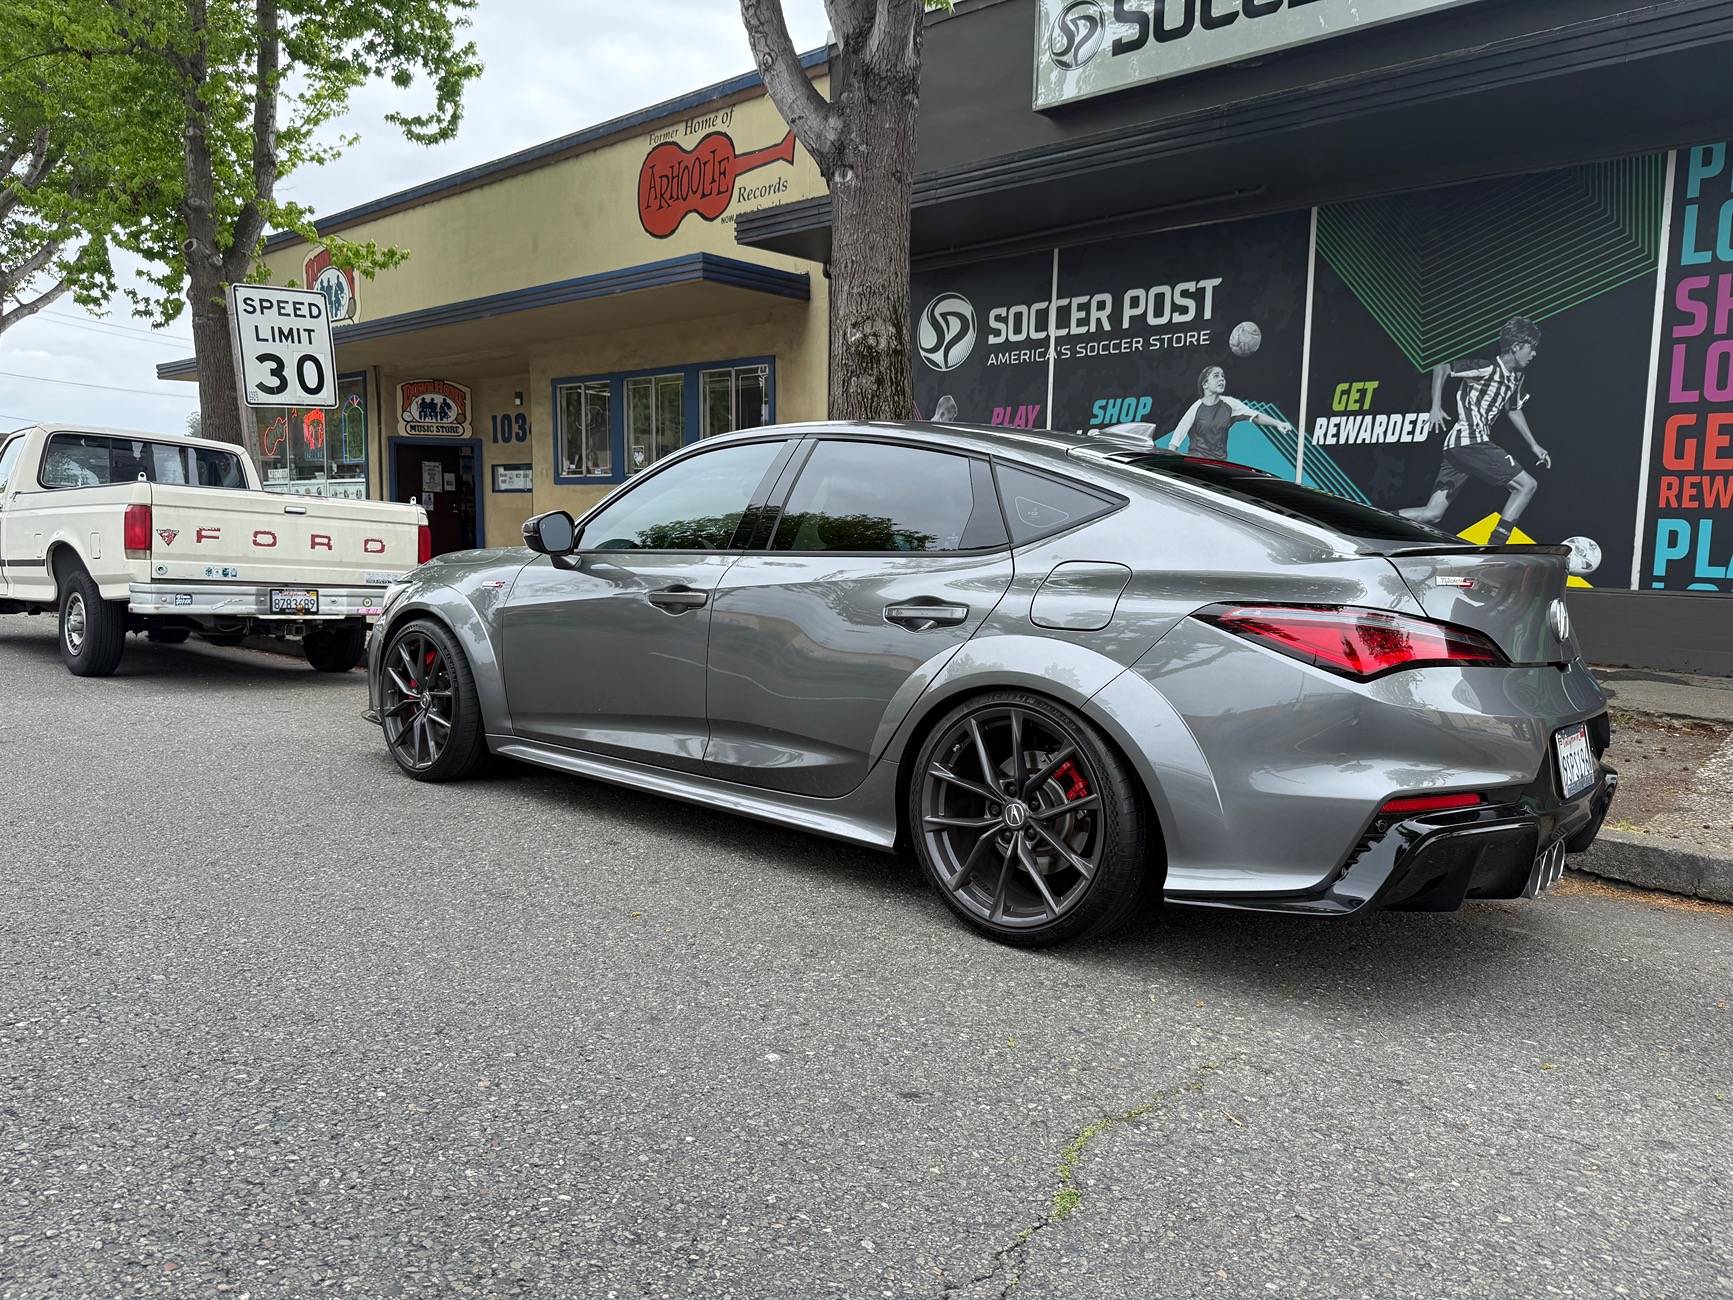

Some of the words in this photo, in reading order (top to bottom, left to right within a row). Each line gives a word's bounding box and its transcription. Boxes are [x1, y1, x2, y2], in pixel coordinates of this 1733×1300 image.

[648, 129, 680, 145] Former
[683, 116, 718, 136] Home
[721, 104, 736, 128] of
[644, 149, 730, 211] ARHOOLIE
[1687, 142, 1733, 199] P
[737, 176, 788, 203] Records
[243, 297, 322, 319] SPEED
[988, 293, 1112, 345] SOCCER
[1122, 277, 1223, 329] POST
[254, 325, 316, 345] LIMIT
[987, 346, 1072, 367] AMERICA'S
[1076, 337, 1143, 358] SOCCER
[1149, 329, 1211, 351] STORE
[255, 353, 325, 396] 30
[1089, 396, 1153, 426] SHOP
[1332, 380, 1380, 412] GET
[409, 424, 435, 434] MUSIC
[435, 425, 460, 434] STORE
[491, 413, 532, 444] 103
[991, 404, 1041, 430] PLAY
[1311, 412, 1432, 447] REWARDED
[196, 527, 386, 554] FORD
[1652, 518, 1733, 579] PL
